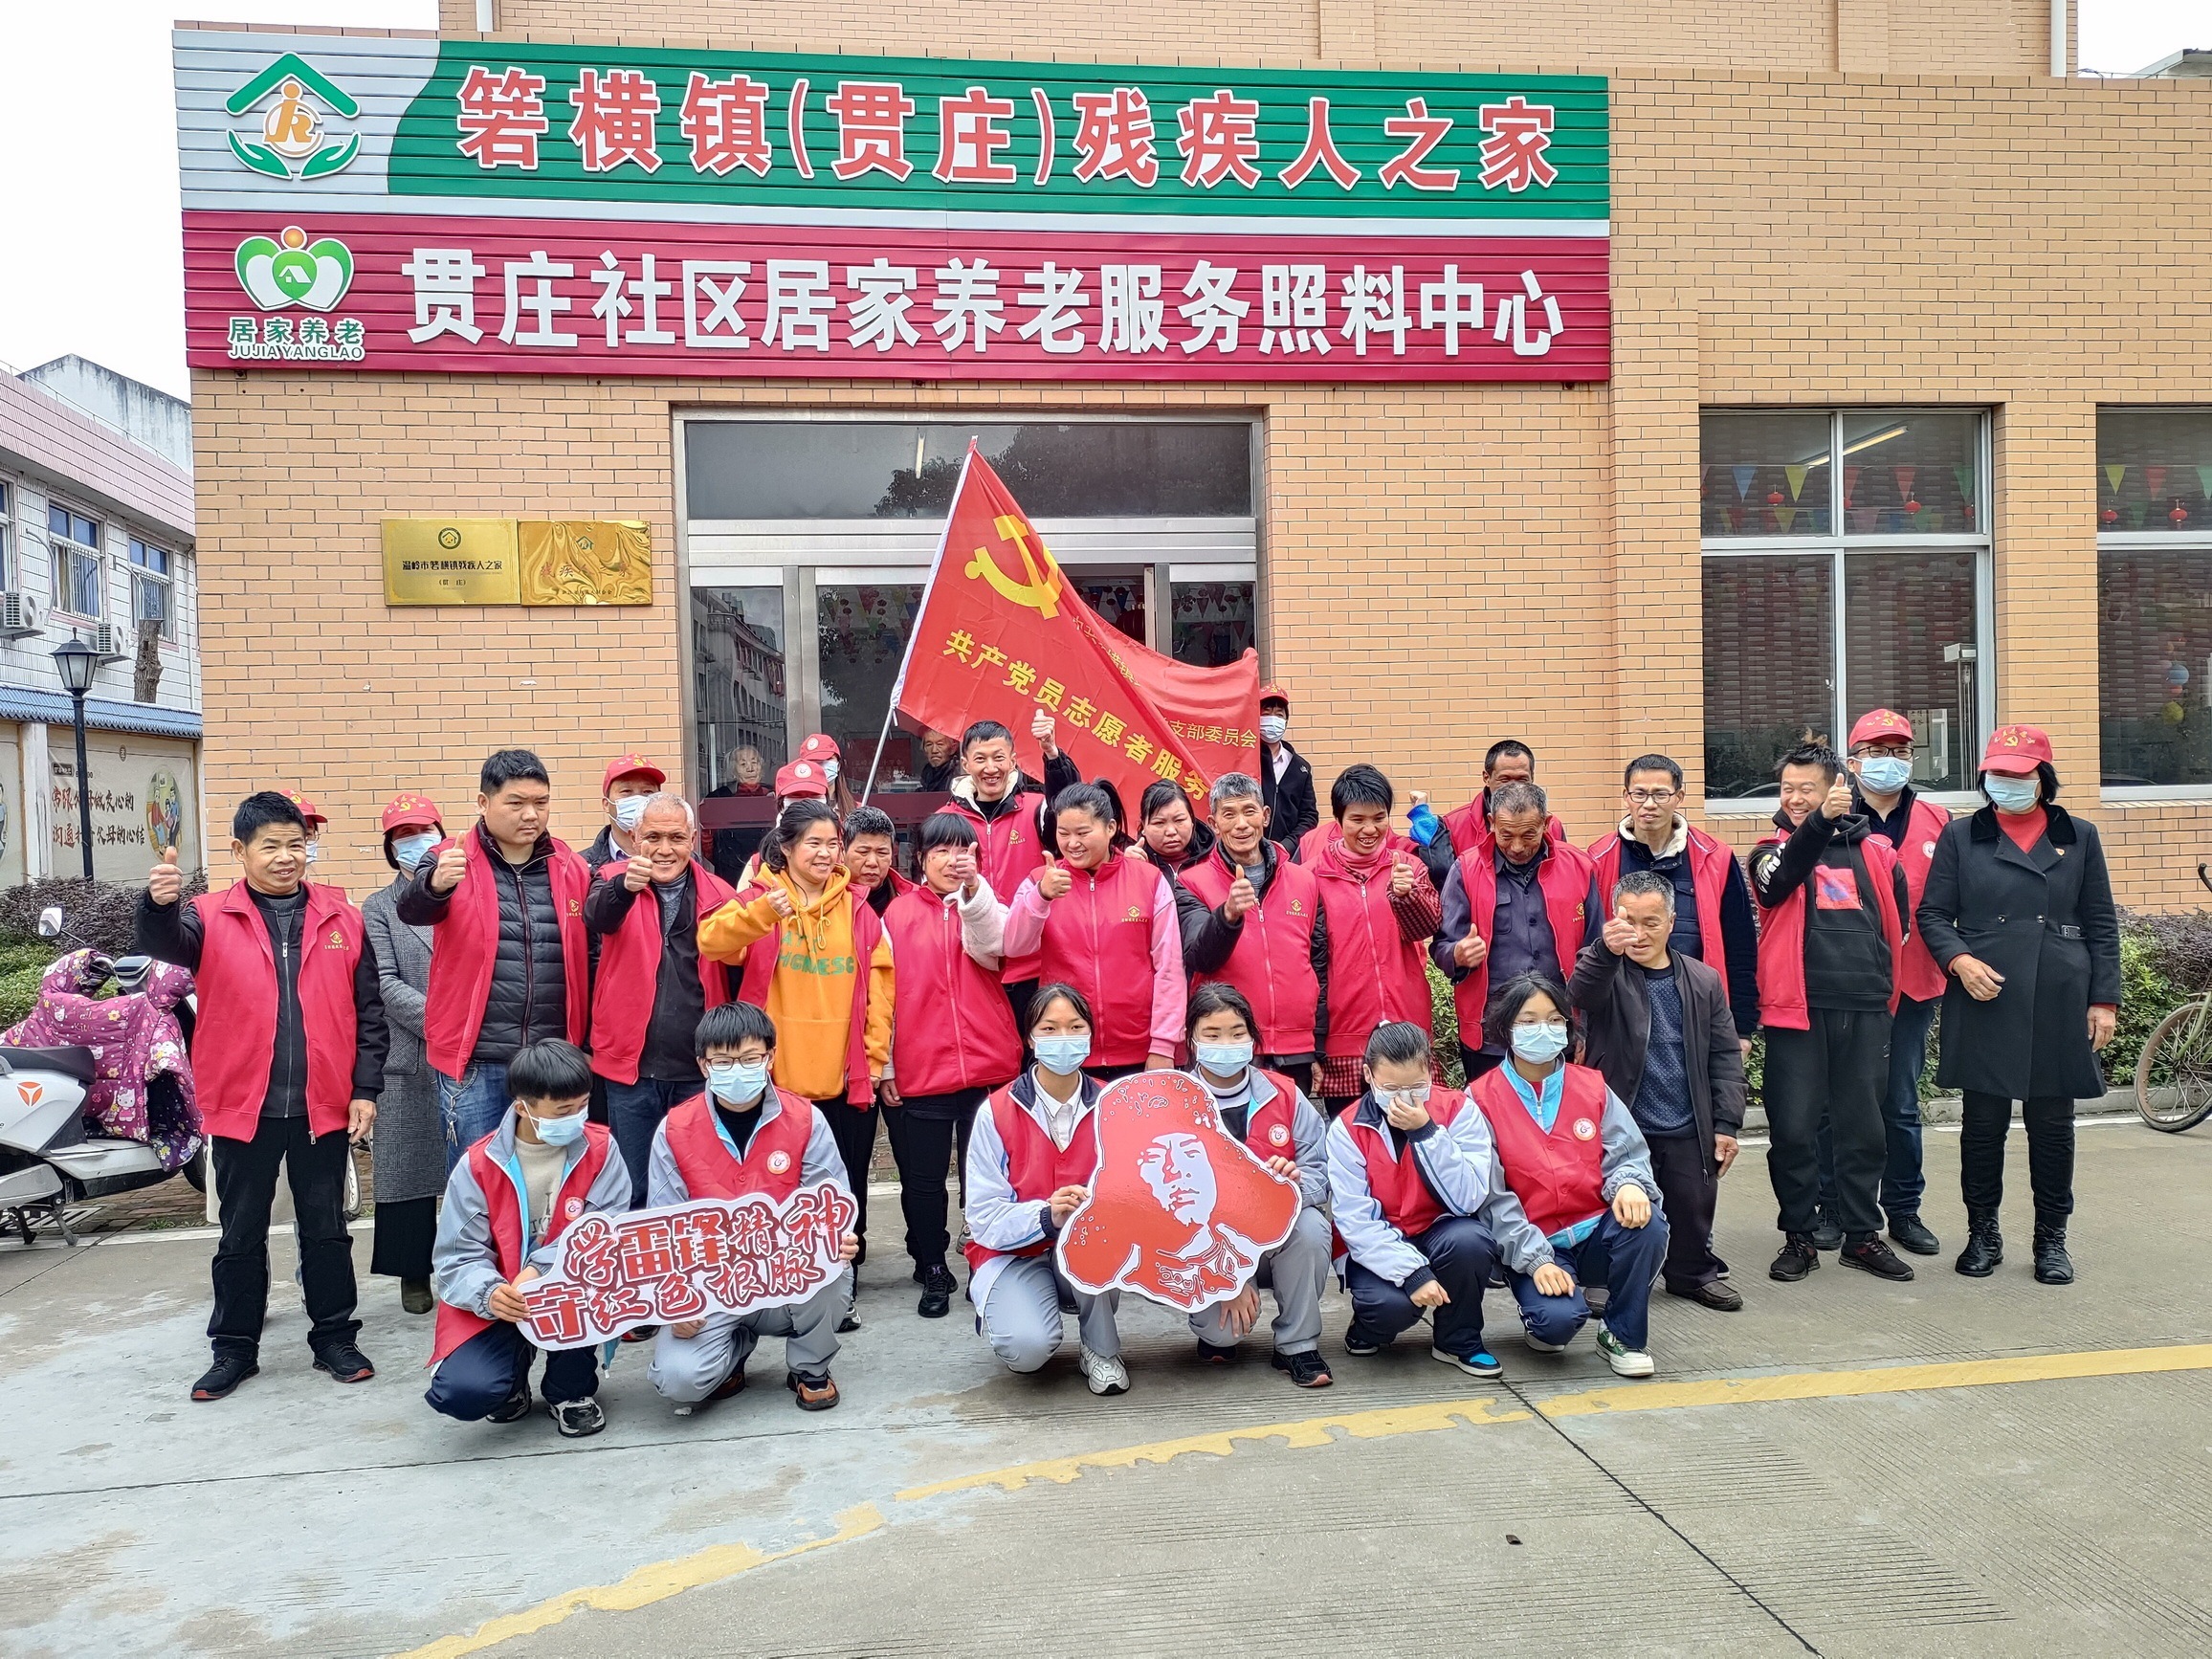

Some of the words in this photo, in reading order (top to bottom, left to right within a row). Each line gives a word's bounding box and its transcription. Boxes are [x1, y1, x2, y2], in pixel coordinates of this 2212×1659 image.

[454, 63, 1559, 193] 箬横镇(贯庄)残疾人之家
[229, 318, 364, 345] 居家养老
[402, 247, 1564, 358] 贯庄社区居家养老服务照料中心
[942, 628, 1210, 802] 共产党员志愿者服务
[1162, 717, 1257, 749] 支部委员会
[568, 1184, 853, 1288] 学雷锋精神
[525, 1246, 824, 1340] 守红色根脉
